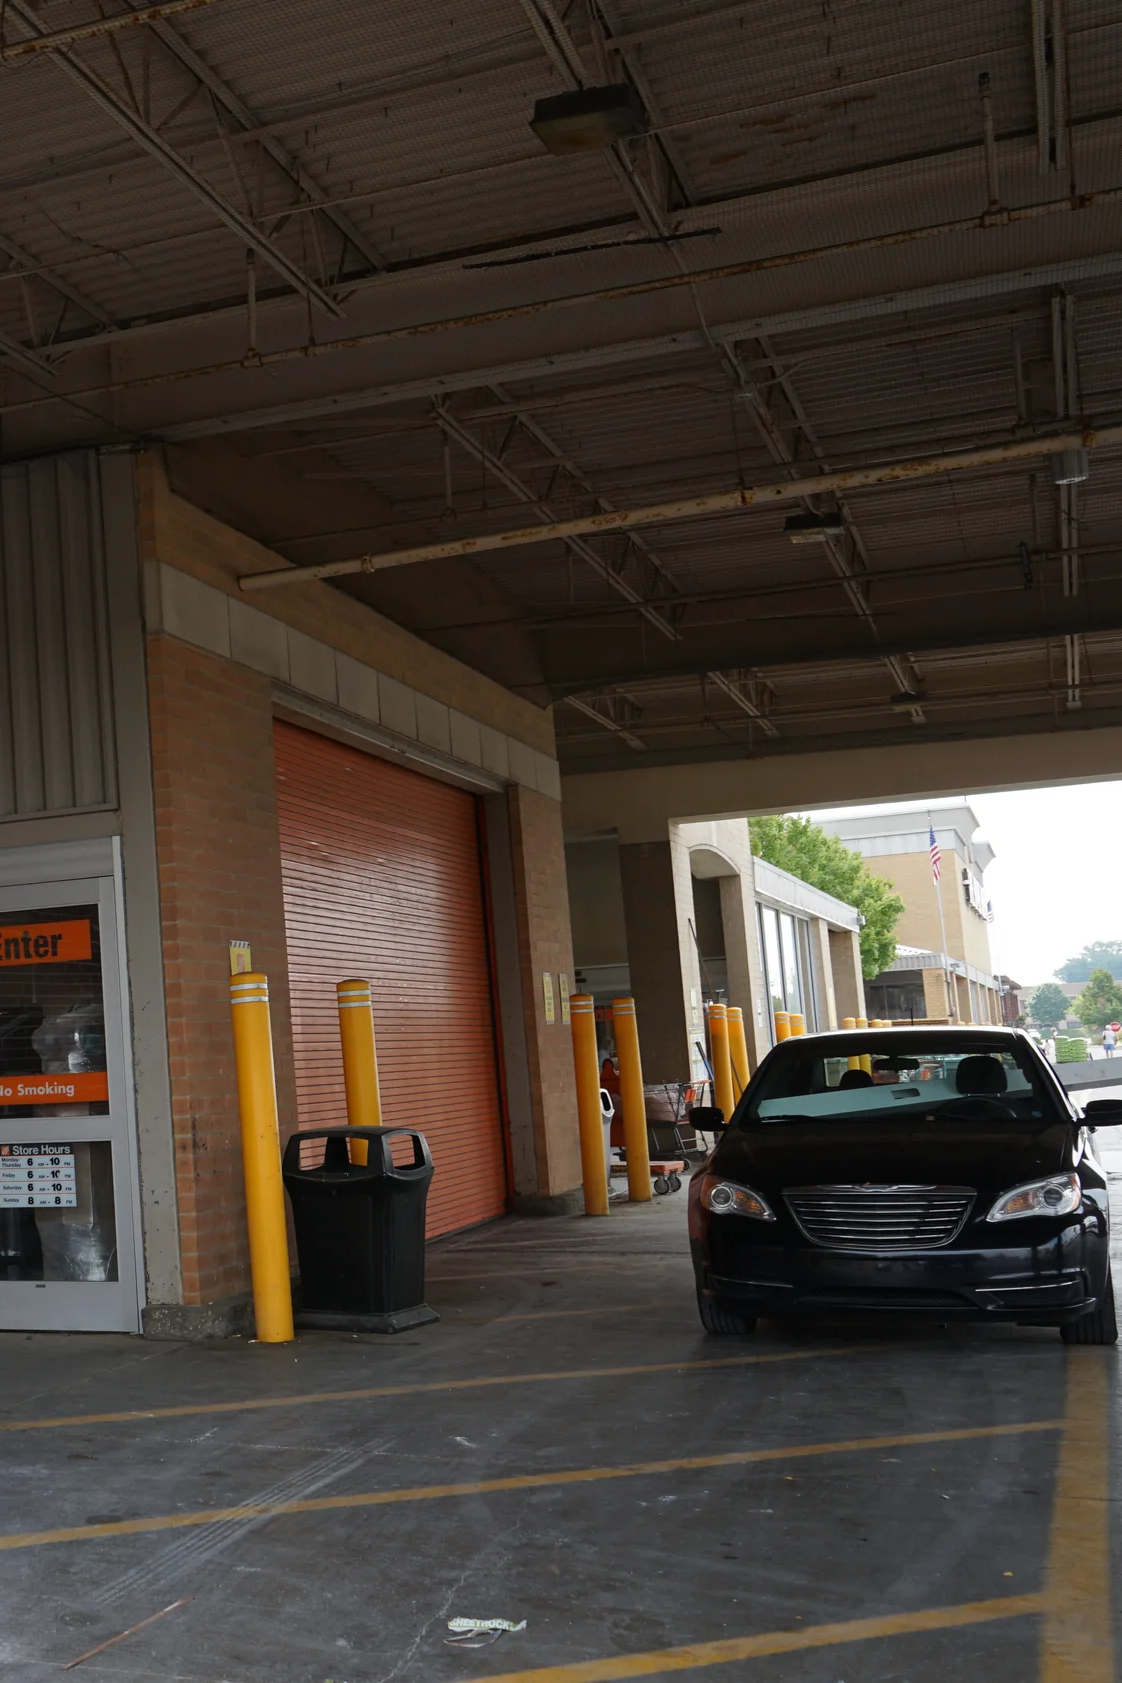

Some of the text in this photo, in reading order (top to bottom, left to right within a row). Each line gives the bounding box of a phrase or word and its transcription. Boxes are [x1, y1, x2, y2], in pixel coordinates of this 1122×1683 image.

[17, 1082, 75, 1097] Smoking
[12, 1144, 71, 1155] Store Hours
[27, 1158, 33, 1166] 6
[49, 1157, 60, 1166] 10
[27, 1170, 33, 1179] 6
[27, 1183, 34, 1191] 6
[51, 1183, 62, 1191] 10
[27, 1196, 34, 1205] 8
[54, 1196, 61, 1205] 8
